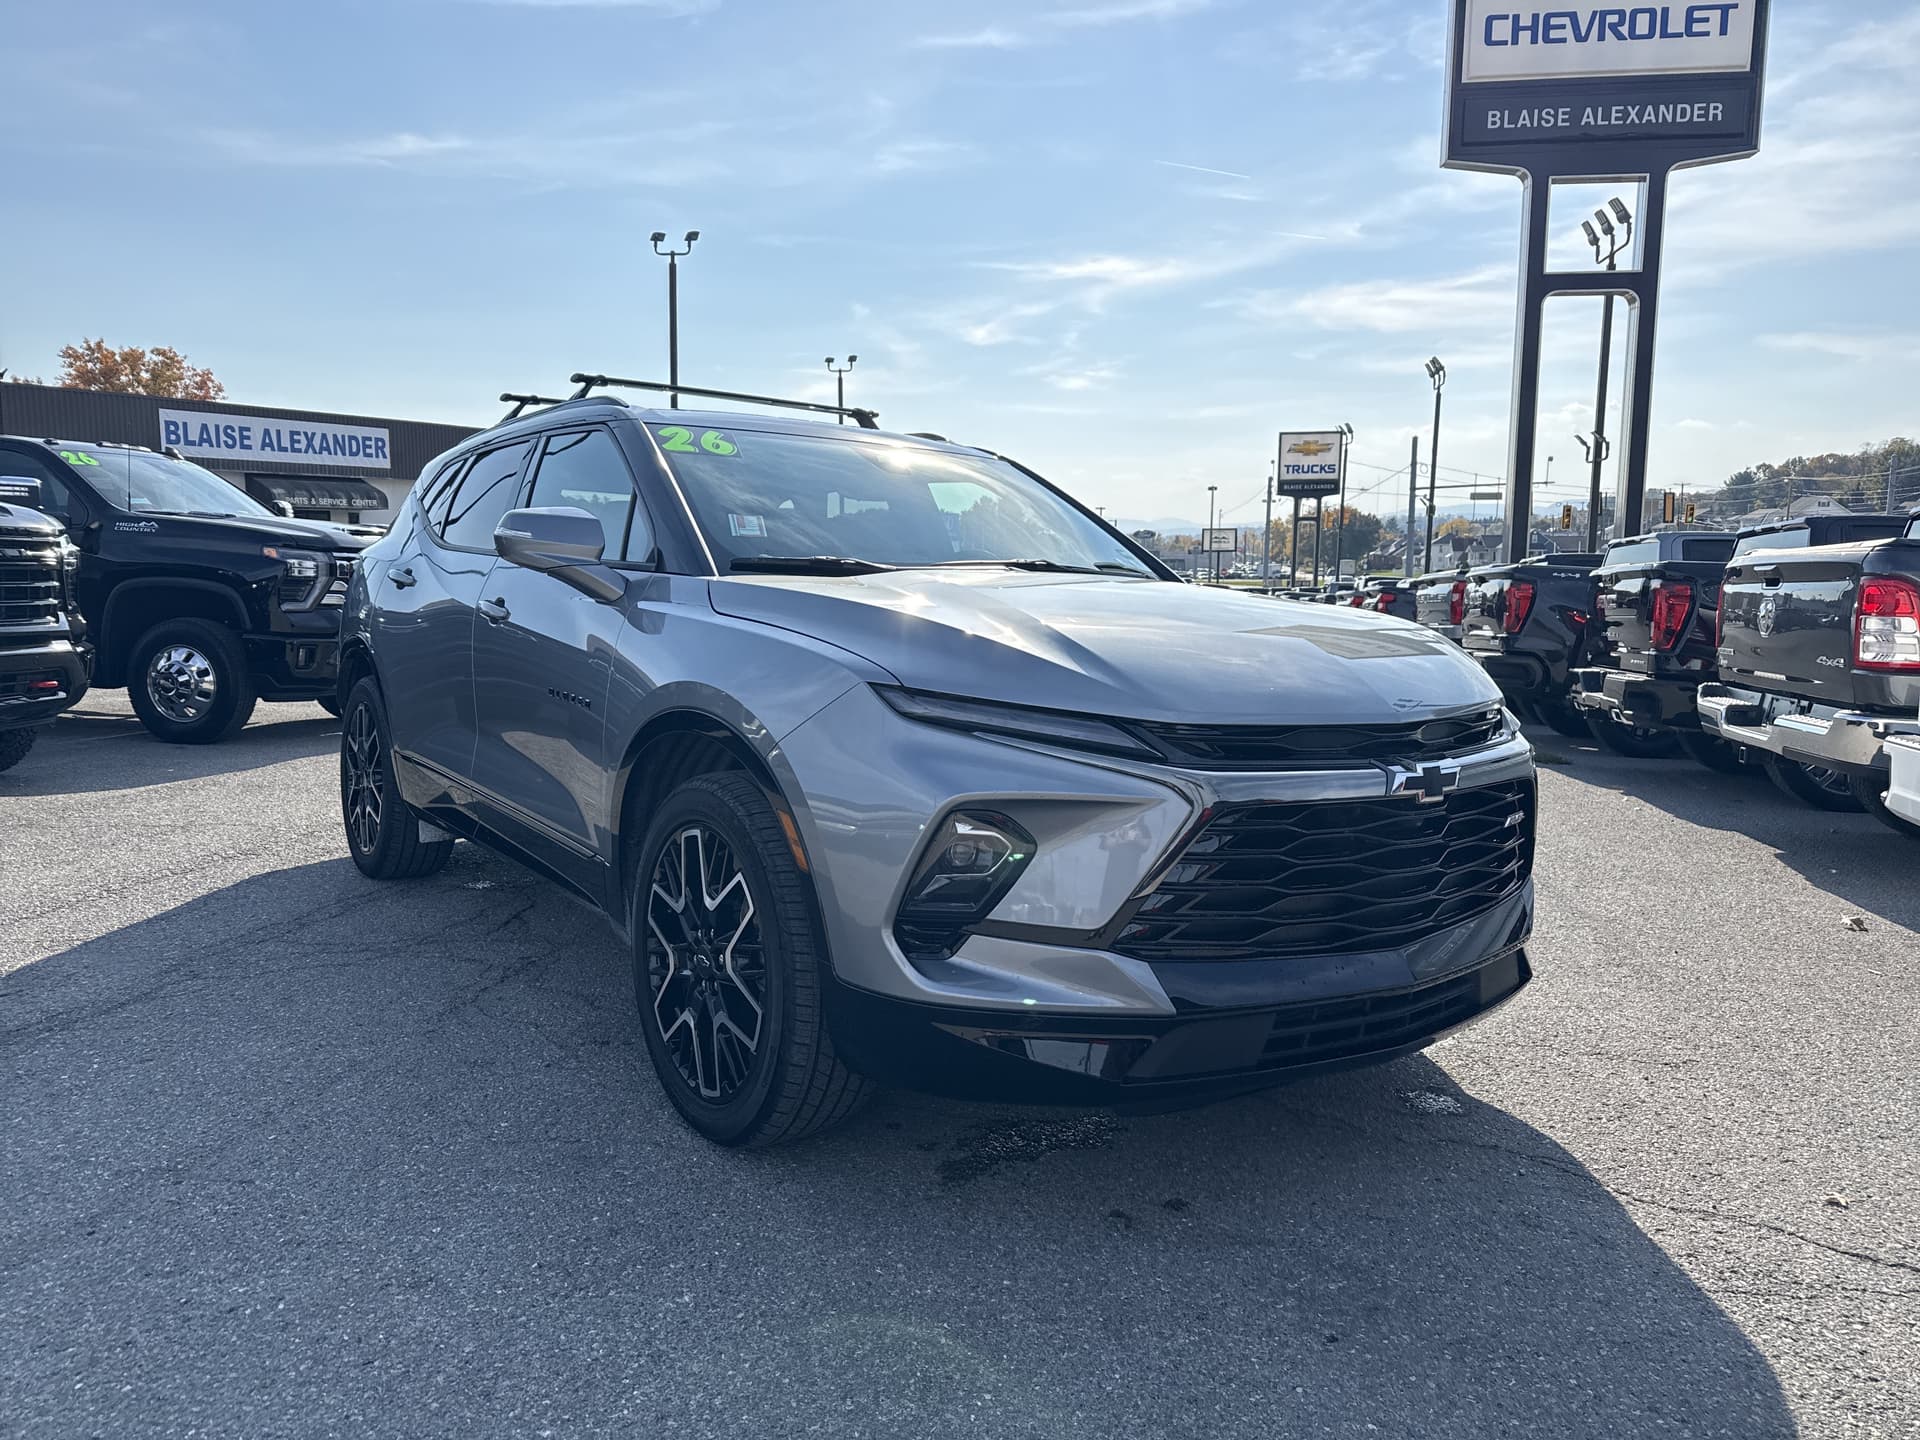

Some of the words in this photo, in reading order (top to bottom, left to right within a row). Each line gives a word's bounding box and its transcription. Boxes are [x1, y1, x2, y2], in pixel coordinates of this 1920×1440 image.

[1484, 3, 1739, 47] CHEVROLET
[1487, 108, 1571, 129] BLAISE
[1581, 103, 1724, 126] ALEXANDER
[163, 420, 253, 450] BLAISE
[260, 428, 388, 460] ALEXANDER
[658, 426, 738, 456] 26
[60, 451, 99, 465] 26
[1284, 464, 1336, 474] TRUCKS
[285, 497, 309, 505] PARTS
[319, 498, 348, 506] SERVICE
[351, 499, 378, 507] CENTER
